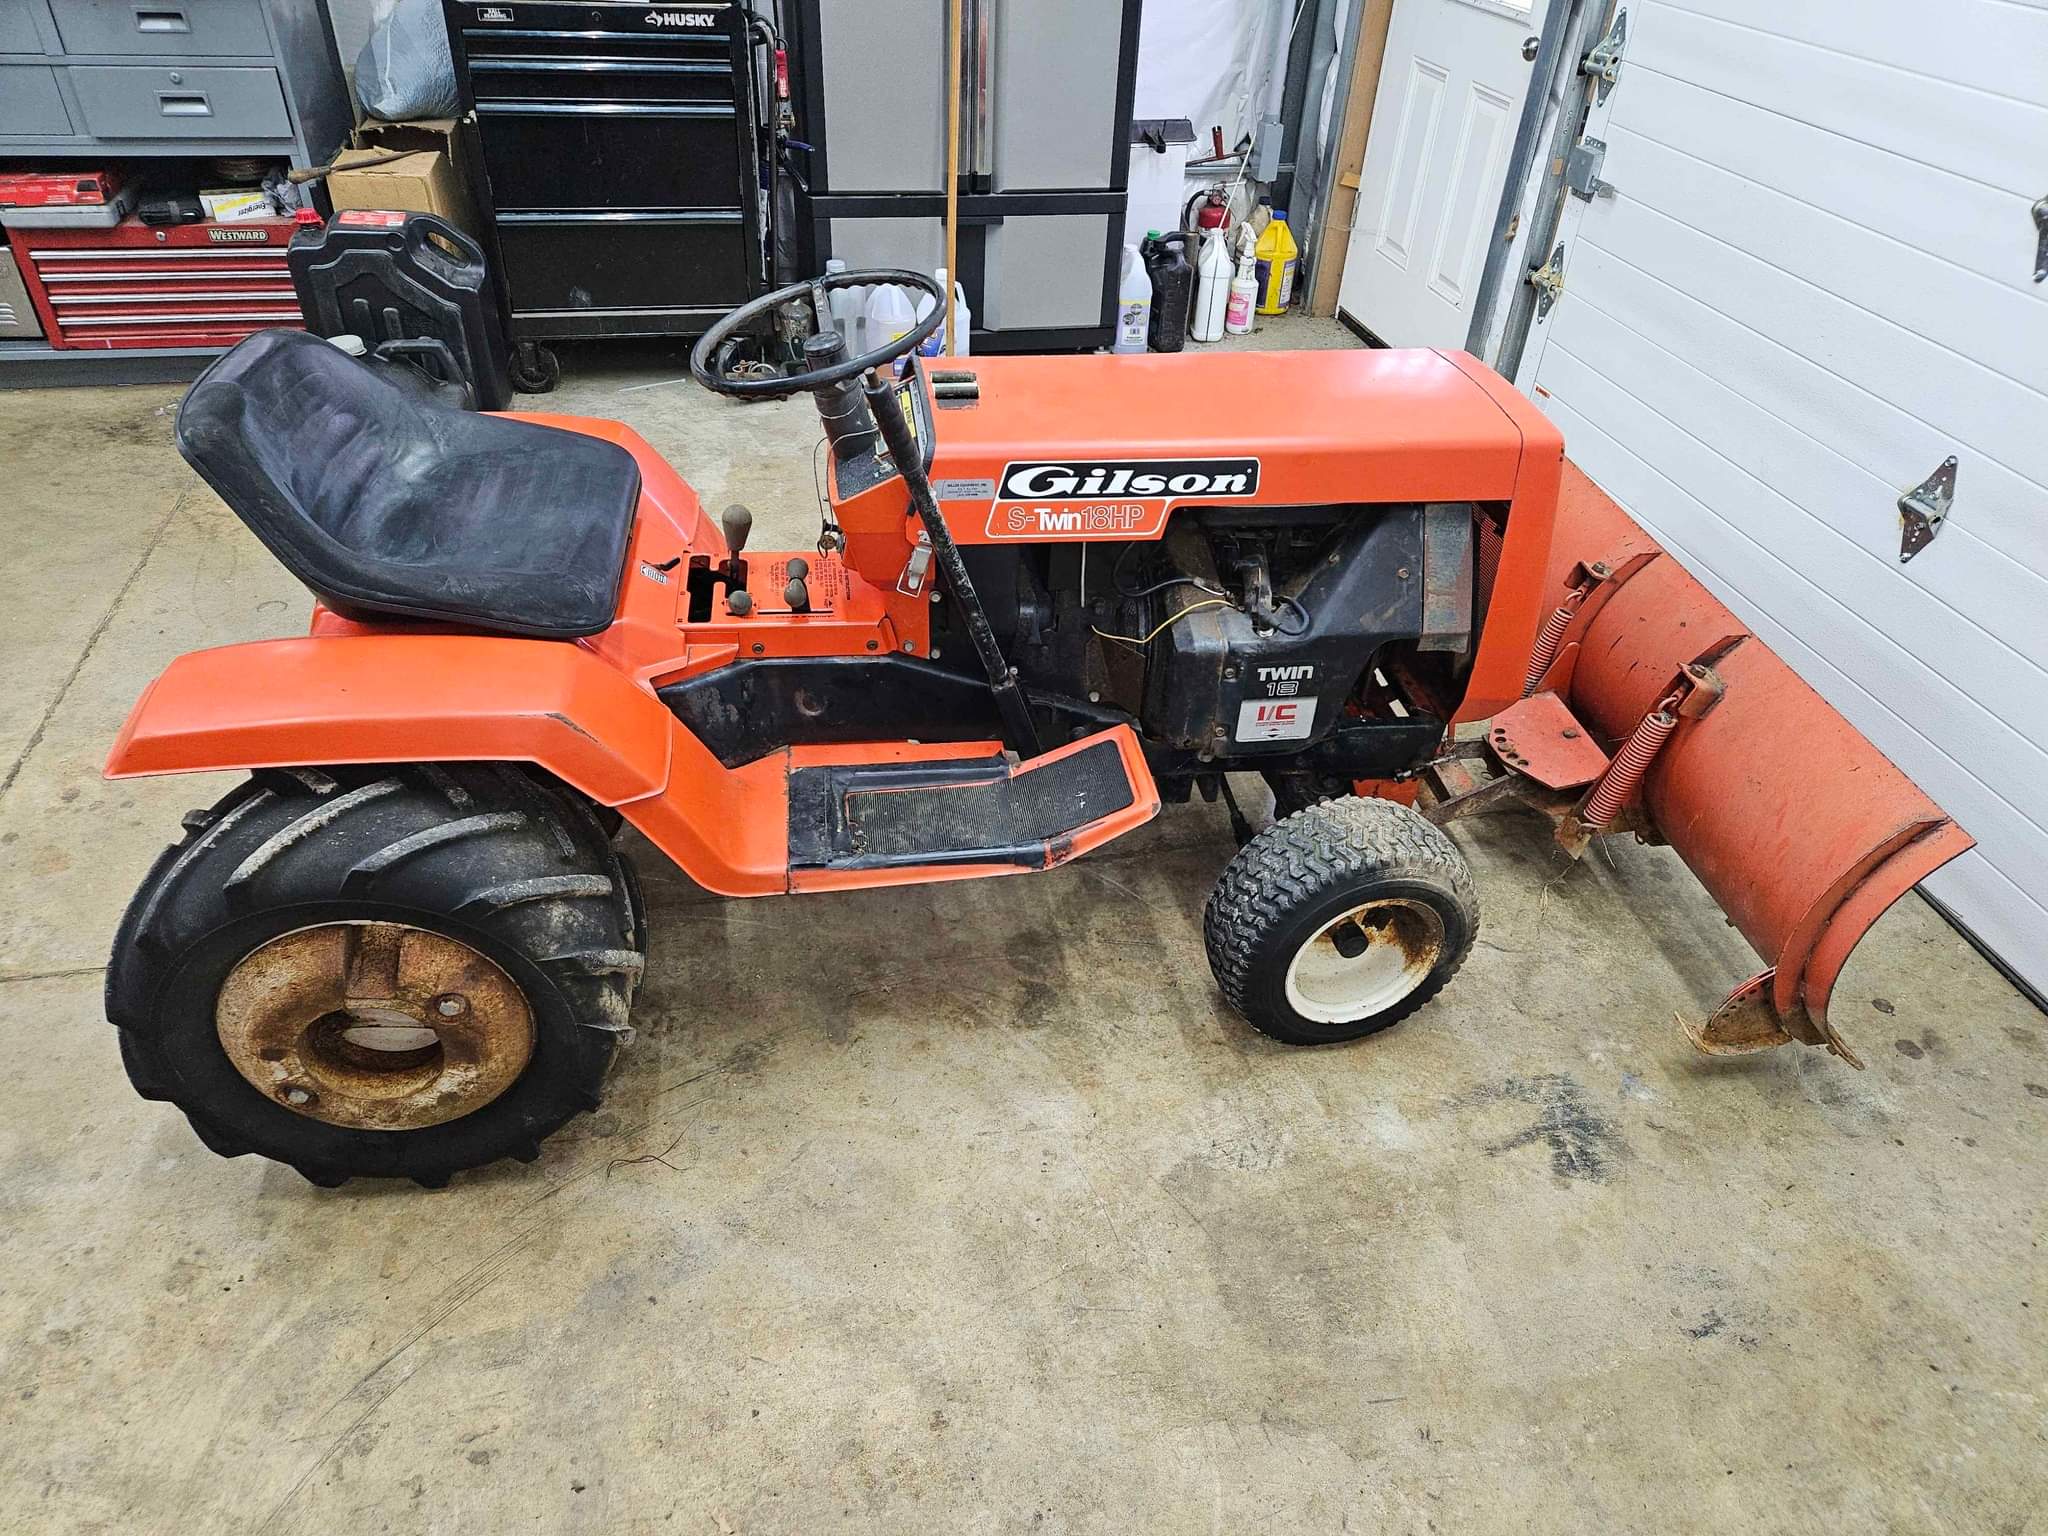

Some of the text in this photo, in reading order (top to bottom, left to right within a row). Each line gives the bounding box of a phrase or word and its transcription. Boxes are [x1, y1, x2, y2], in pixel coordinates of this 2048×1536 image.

[663, 13, 715, 27] HUSKY
[238, 202, 266, 216] Energizer
[1007, 466, 1249, 498] Gilson
[1266, 681, 1299, 697] 18
[1257, 704, 1297, 721] I/C
